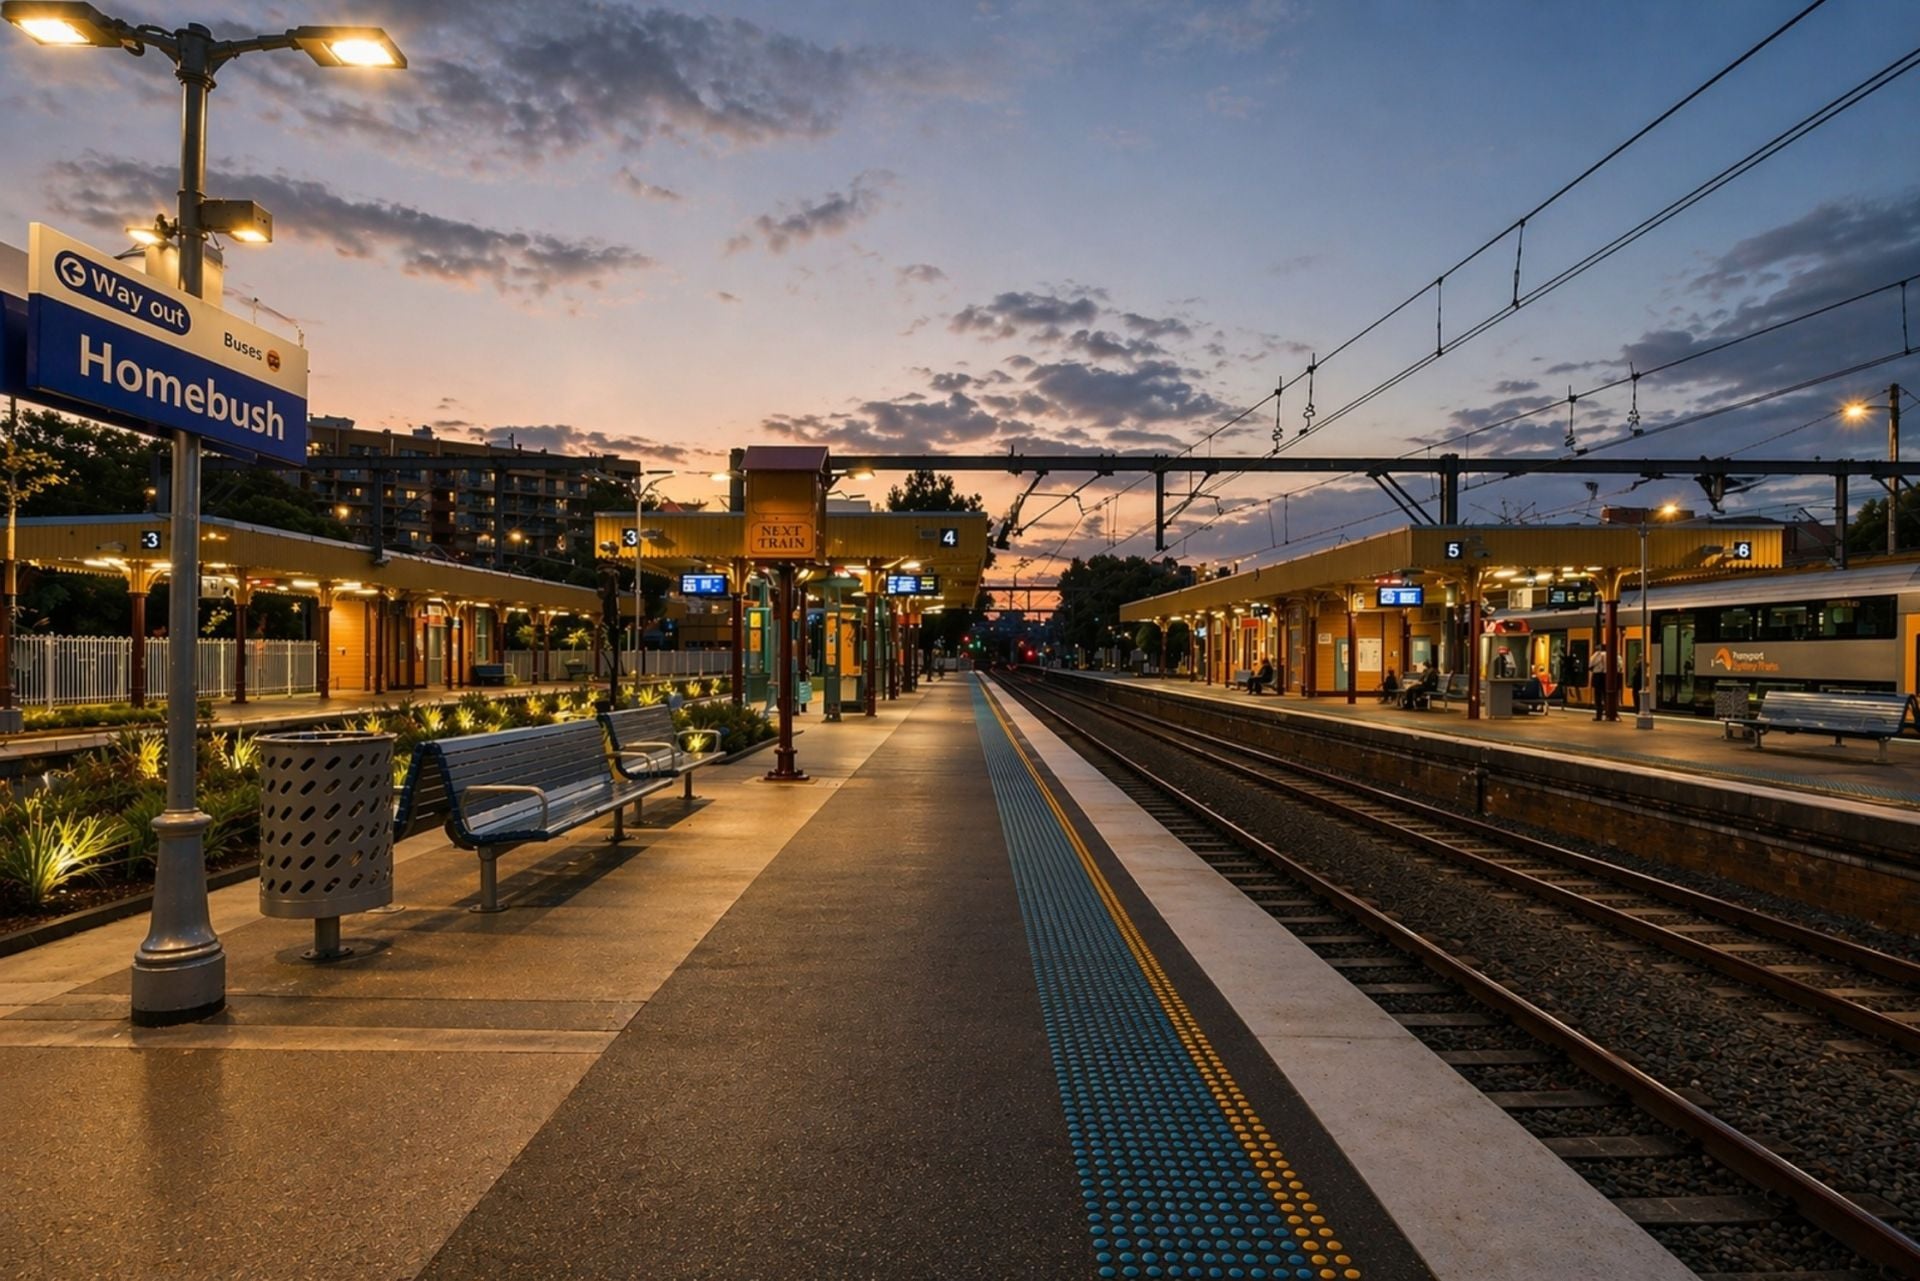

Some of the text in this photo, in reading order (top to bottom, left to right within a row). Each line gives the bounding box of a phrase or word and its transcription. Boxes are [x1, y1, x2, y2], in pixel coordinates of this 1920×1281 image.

[91, 268, 184, 328] Way out
[224, 331, 262, 361] Buses
[80, 334, 285, 440] Homebush
[626, 530, 636, 545] 3
[761, 525, 802, 537] NEXT
[943, 530, 956, 545] 4
[147, 532, 158, 548] 3
[758, 537, 805, 549] TRAIN
[1448, 543, 1459, 558] 5
[1739, 543, 1750, 558] 6
